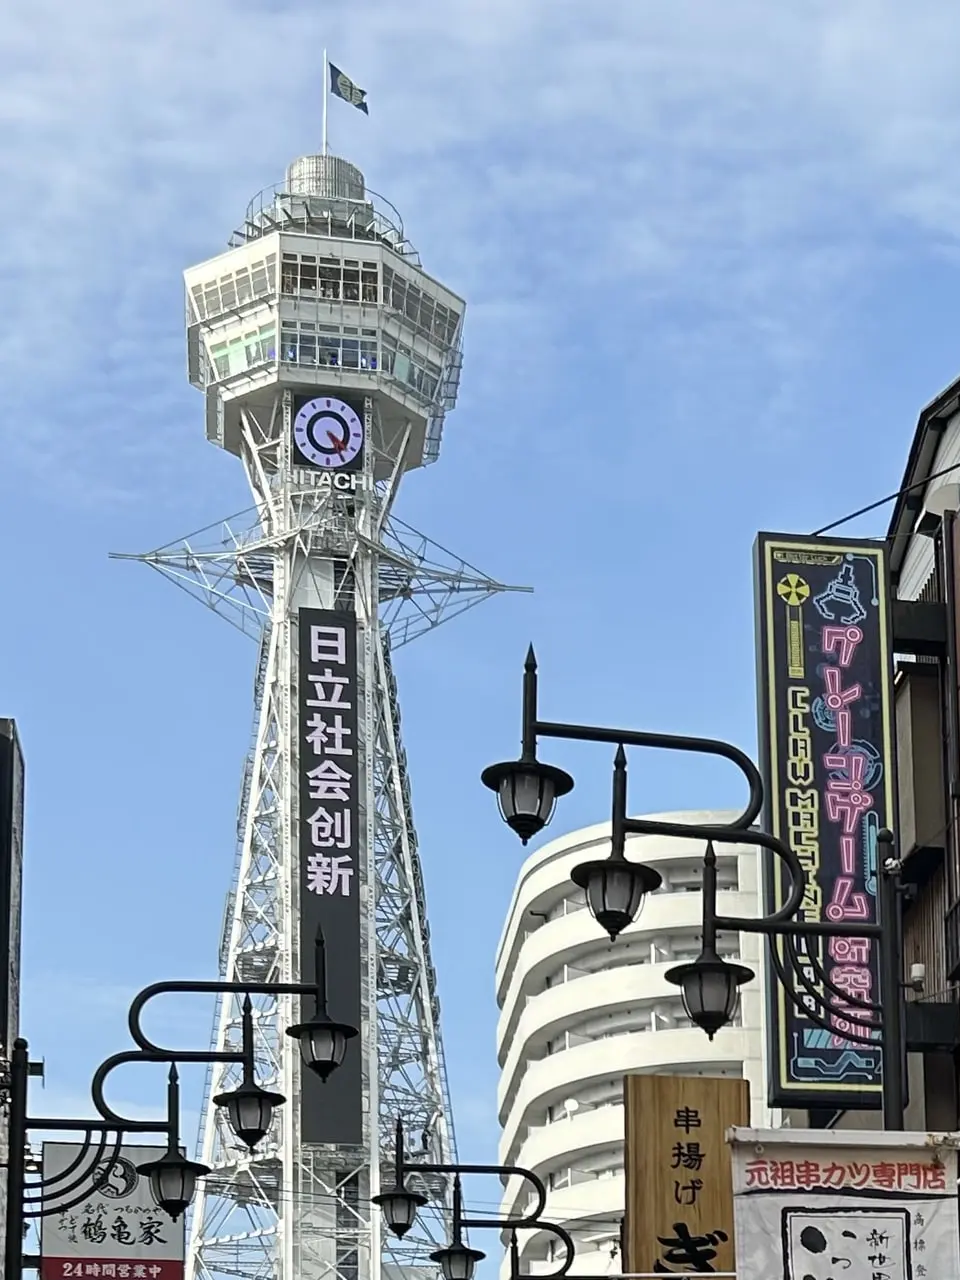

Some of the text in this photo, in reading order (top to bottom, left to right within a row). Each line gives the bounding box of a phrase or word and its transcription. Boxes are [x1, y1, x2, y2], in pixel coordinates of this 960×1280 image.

[291, 470, 373, 491] HITACHI
[672, 1105, 706, 1206] 串揚げ
[745, 1159, 947, 1191] 元祖串カツ専門店
[81, 1213, 168, 1246] 鶴亀家
[62, 1262, 163, 1279] 24時間営業中
